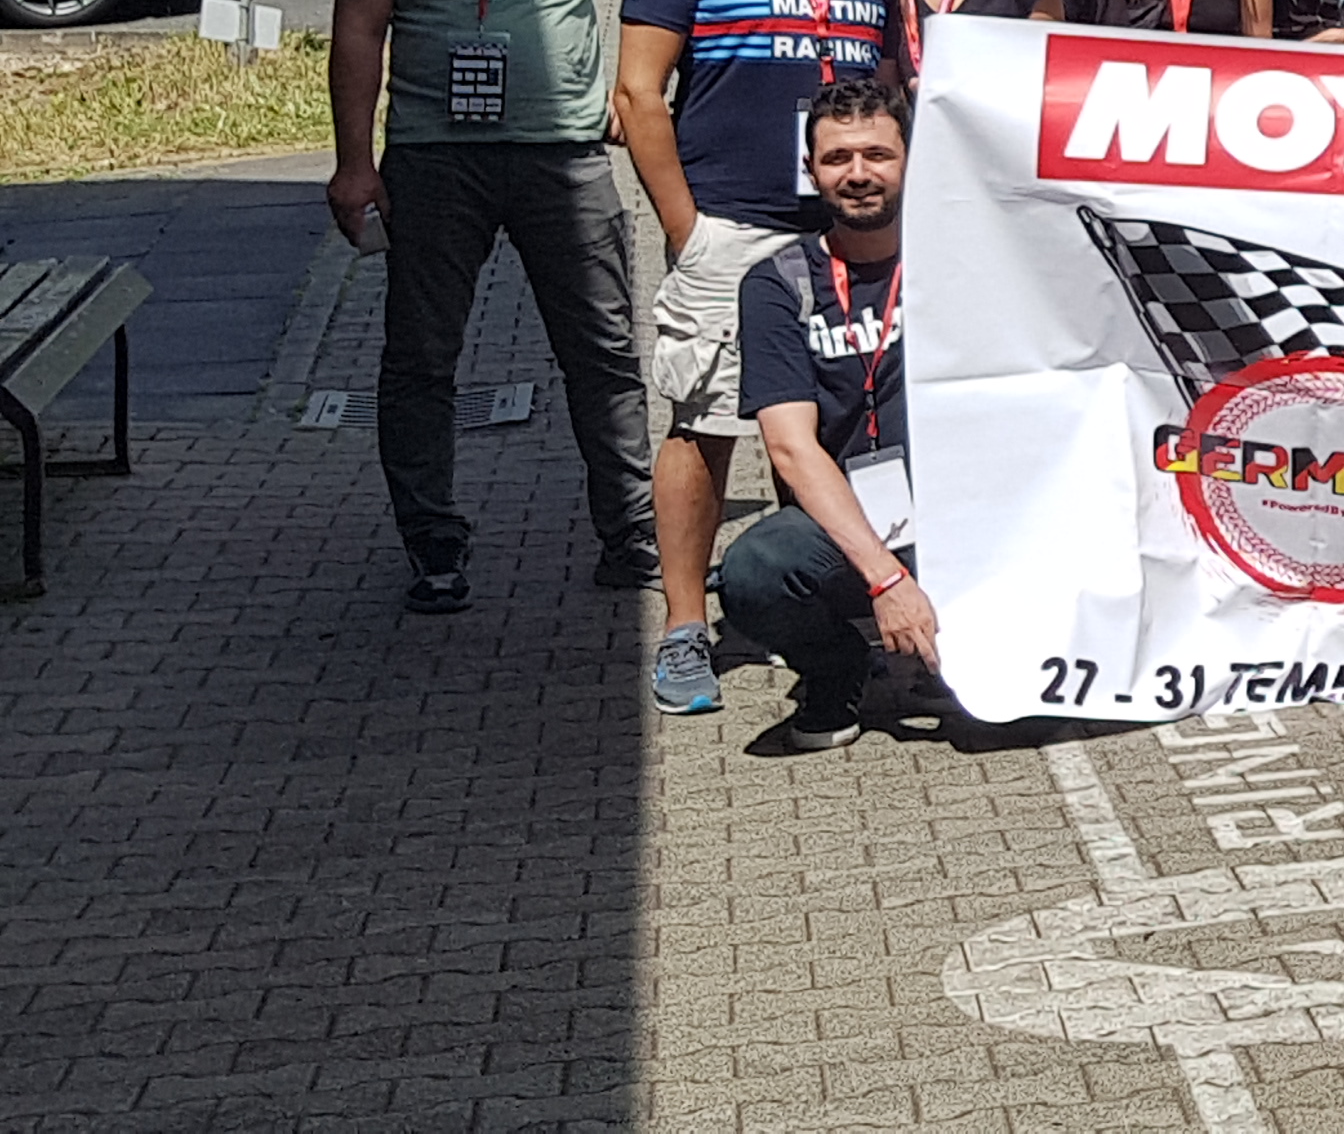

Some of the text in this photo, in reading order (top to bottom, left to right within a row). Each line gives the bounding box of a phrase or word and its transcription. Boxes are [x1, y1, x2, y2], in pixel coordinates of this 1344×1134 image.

[773, 35, 872, 65] RAING
[1040, 656, 1099, 707] 27
[1154, 664, 1206, 710] 31
